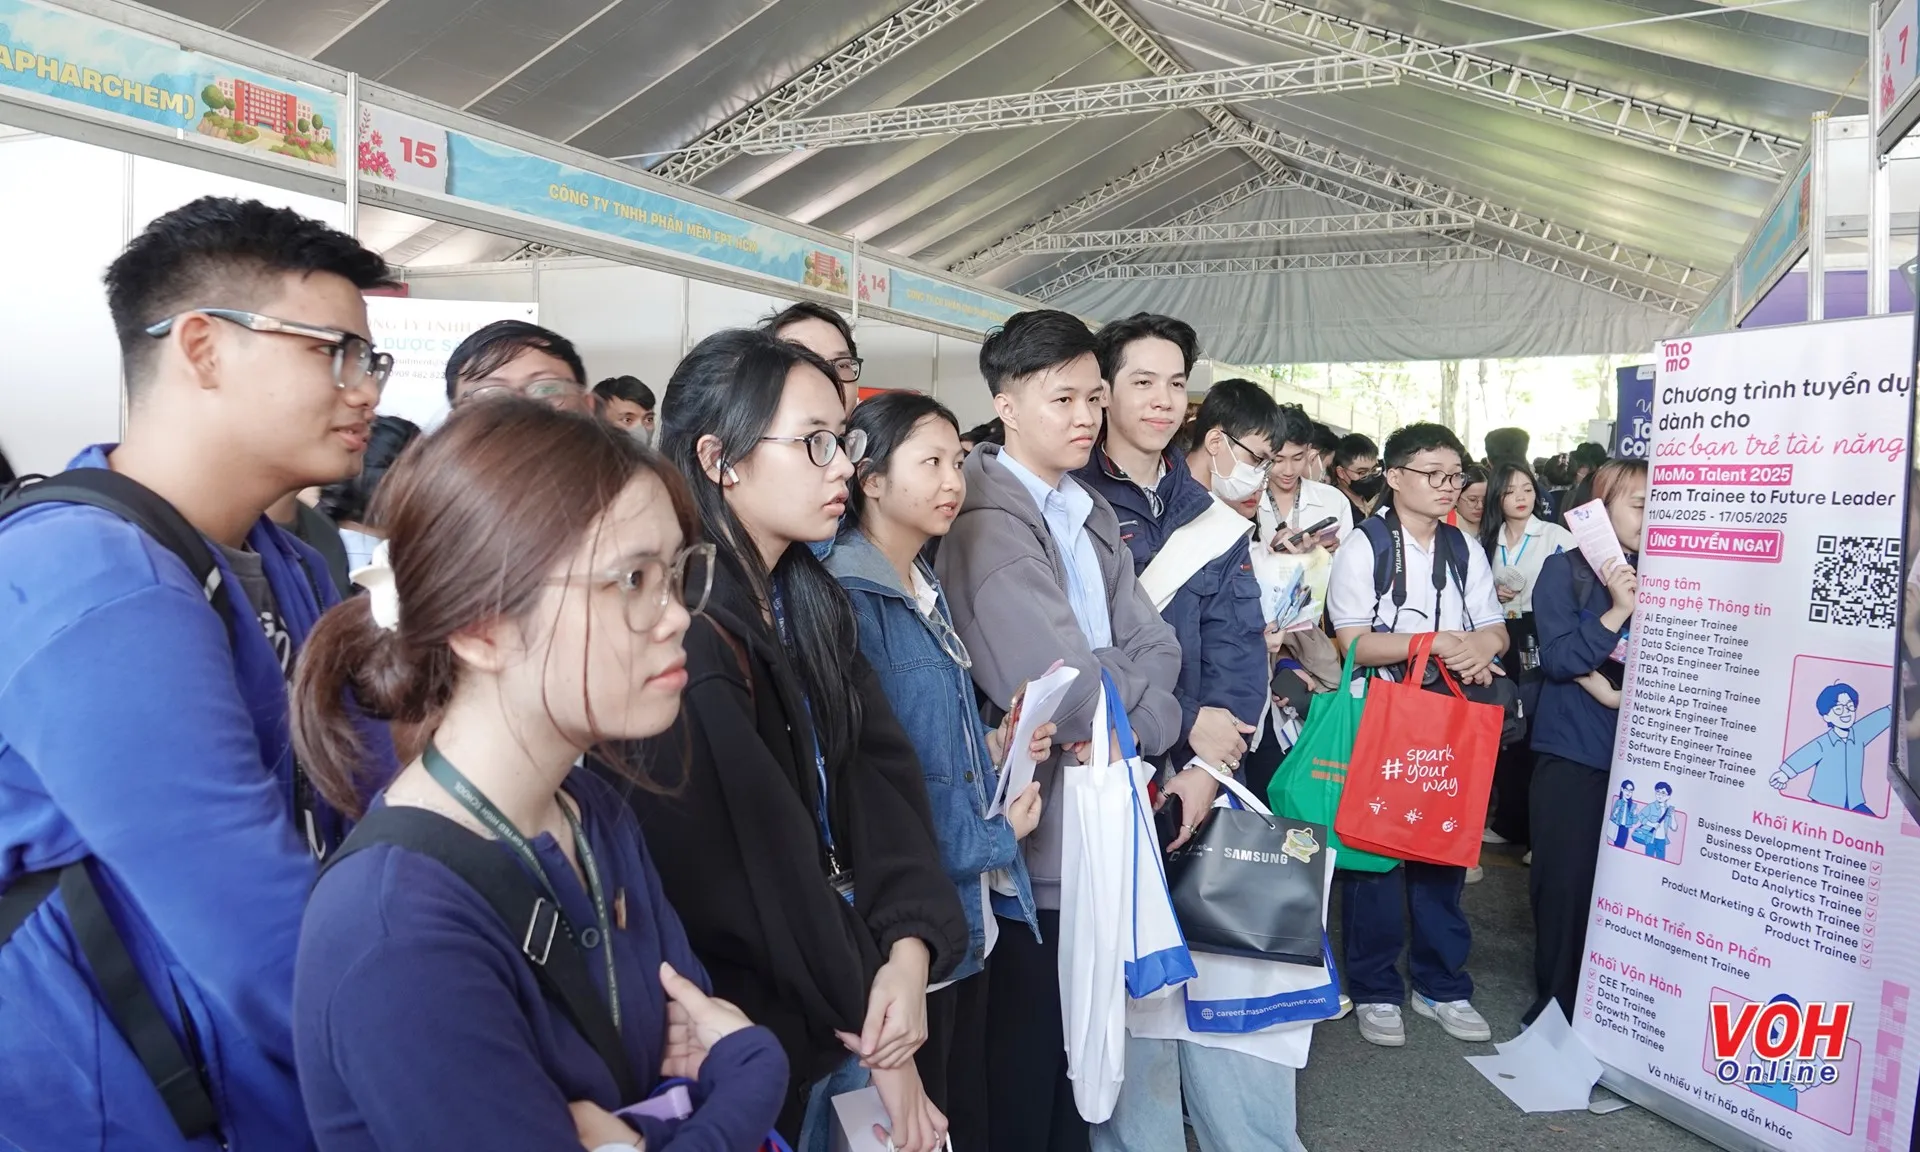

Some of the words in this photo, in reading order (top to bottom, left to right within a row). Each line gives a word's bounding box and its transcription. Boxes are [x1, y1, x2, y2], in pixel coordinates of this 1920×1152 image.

[1898, 25, 1909, 65] 7
[399, 136, 438, 169] 15
[549, 183, 589, 208] CÔNG
[593, 196, 609, 212] TY
[613, 202, 647, 223] TNHH
[714, 233, 733, 245] FPT
[871, 274, 886, 292] 14
[1662, 382, 1737, 405] Chương
[1744, 379, 1796, 400] trình
[1803, 372, 1870, 400] tuyển
[1659, 411, 1704, 431] dành
[1711, 411, 1750, 429] cho
[1656, 433, 1686, 457] các
[1689, 433, 1737, 461] bạn
[1746, 432, 1780, 456] trẻ
[1788, 433, 1824, 454] tài
[1833, 434, 1905, 462] năng
[1654, 468, 1695, 482] MoMo
[1699, 467, 1746, 482] Talent
[1750, 467, 1791, 482] 2025
[1651, 489, 1682, 503] From
[1686, 489, 1745, 504] Trainee
[1750, 490, 1766, 504] to
[1771, 489, 1826, 506] Future
[1832, 490, 1896, 506] Leader
[1649, 510, 1706, 522] 11/04/2025
[1720, 511, 1788, 524] 17/05/2025
[1650, 530, 1677, 549] ỨNG
[1680, 533, 1730, 552] TUYỂN
[1733, 538, 1774, 553] NGAY
[1641, 575, 1670, 590] Trung
[1675, 576, 1700, 590] tâm
[1639, 592, 1666, 607] Công
[1670, 596, 1703, 613] nghệ
[1708, 598, 1750, 616] Thông
[1755, 602, 1771, 616] tin
[1643, 626, 1664, 637] Data
[1666, 629, 1710, 644] Engineer
[1714, 634, 1749, 647] Trainee
[1644, 612, 1653, 622] AI
[1656, 614, 1698, 629] Engineer
[1701, 619, 1738, 631] Trainee
[1640, 651, 1674, 665] DevOps
[1678, 656, 1722, 671] Engineer
[1725, 663, 1760, 676] Trainee
[1641, 638, 1662, 649] Data
[1665, 641, 1704, 655] Science
[1707, 647, 1743, 660] Trainee
[1638, 664, 1659, 675] ITBA
[1662, 668, 1699, 681] Trainee
[1635, 689, 1665, 703] Mobile
[1668, 695, 1689, 707] App
[1693, 700, 1728, 714] Trainee
[1636, 676, 1675, 691] Machine
[1679, 683, 1722, 700] Learning
[1725, 691, 1760, 705] Trainee
[1631, 714, 1645, 725] QC
[1648, 718, 1691, 735] Engineer
[1694, 727, 1728, 741] Trainee
[1633, 702, 1672, 717] Network
[1675, 710, 1718, 726] Engineer
[1720, 718, 1757, 733] Trainee
[1406, 744, 1455, 767] spark
[1628, 740, 1671, 758] Software
[1674, 750, 1716, 767] Engineer
[1719, 760, 1756, 776] Trainee
[1630, 728, 1668, 745] Security
[1671, 735, 1714, 752] Engineer
[1716, 745, 1752, 761] Trainee
[1405, 763, 1449, 784] your
[1627, 753, 1660, 770] System
[1664, 762, 1707, 779] Engineer
[1709, 771, 1745, 788] Trainee
[1422, 777, 1458, 797] way
[1697, 817, 1742, 839] Business
[1744, 830, 1821, 860] Development
[1824, 851, 1867, 871] Trainee
[1752, 810, 1787, 832] Khối
[1791, 820, 1828, 841] Kinh
[1832, 830, 1885, 856] Doanh
[1224, 847, 1289, 865] SAMSUNG
[1706, 834, 1752, 856] Business
[1756, 847, 1819, 873] Operations
[1822, 865, 1865, 886] Trainee
[1700, 847, 1751, 871] Customer
[1754, 861, 1817, 888] Experience
[1821, 880, 1864, 902] Trainee
[1731, 870, 1759, 885] Data
[1761, 878, 1816, 904] Analytics
[1819, 895, 1862, 917] Trainee
[1661, 877, 1698, 897] Product
[1700, 888, 1754, 916] Marketing
[1769, 911, 1812, 936] Growth
[1815, 927, 1858, 948] Trainee
[1771, 897, 1814, 921] Growth
[1817, 911, 1860, 933] Trainee
[1597, 897, 1623, 916] Khối
[1627, 908, 1658, 928] Phát
[1662, 917, 1692, 941] Triển
[1696, 931, 1724, 953] Sản
[1728, 942, 1772, 969] Phẩm
[1765, 925, 1810, 950] Product
[1813, 942, 1857, 964] Trainee
[1605, 919, 1642, 941] Product
[1644, 932, 1708, 966] Management
[1711, 956, 1750, 980] Trainee
[1590, 951, 1616, 971] Khối
[1620, 962, 1646, 983] Vận
[1649, 973, 1682, 998] Hành
[1599, 974, 1618, 990] CEE
[1620, 982, 1655, 1004] Trainee
[1597, 987, 1621, 1005] Data
[1623, 997, 1657, 1020] Trainee
[1594, 1014, 1629, 1037] OpTech
[1631, 1028, 1665, 1053] Trainee
[1596, 1001, 1630, 1024] Growth
[1632, 1015, 1666, 1038] Trainee
[1648, 1063, 1662, 1077] Và
[1663, 1069, 1690, 1094] nhiều
[1692, 1085, 1702, 1101] vị
[1704, 1088, 1717, 1104] trí
[1718, 1095, 1738, 1115] hấp
[1740, 1105, 1762, 1128] dẫn
[1765, 1117, 1793, 1140] khác
